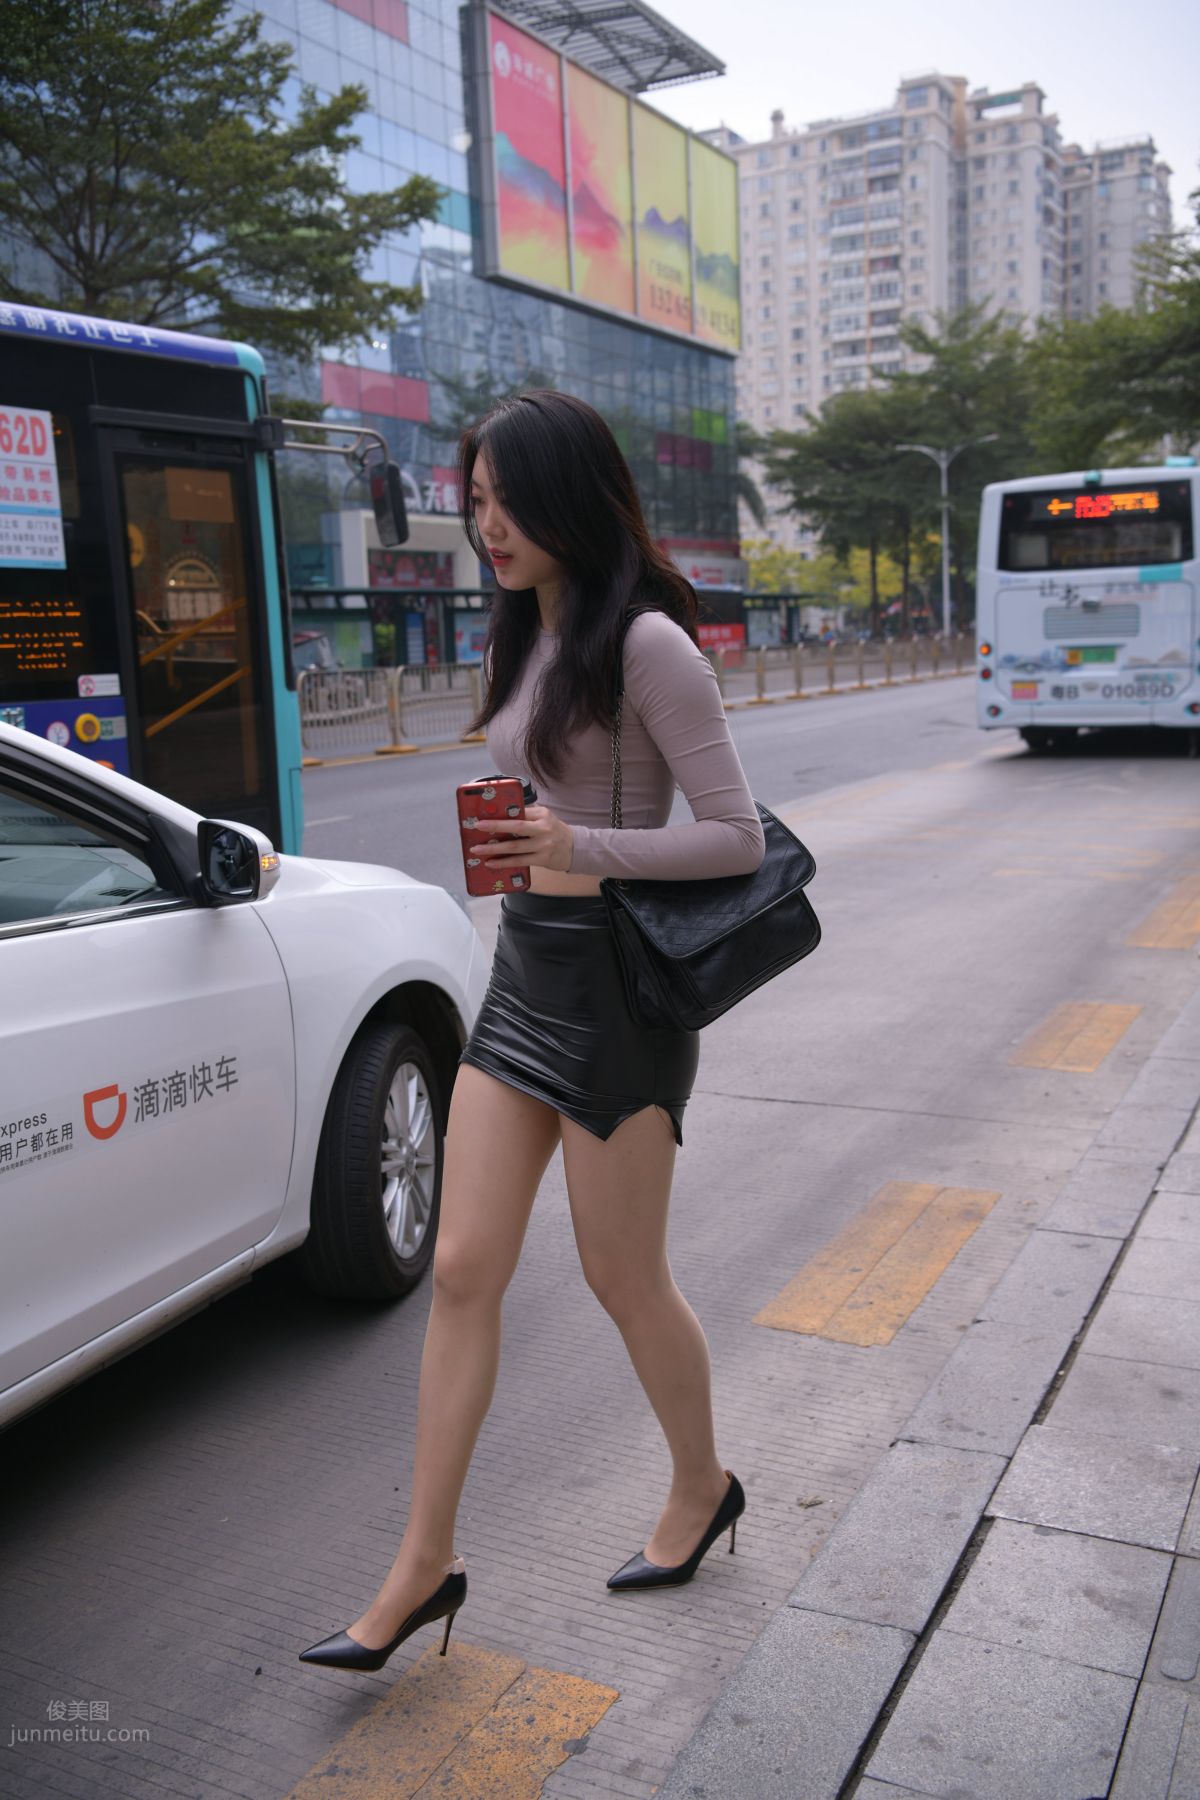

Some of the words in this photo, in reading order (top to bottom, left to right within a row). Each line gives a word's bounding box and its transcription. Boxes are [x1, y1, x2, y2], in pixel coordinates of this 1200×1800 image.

[133, 1055, 239, 1123] 滴滴快车
[0, 1112, 47, 1138] xpress
